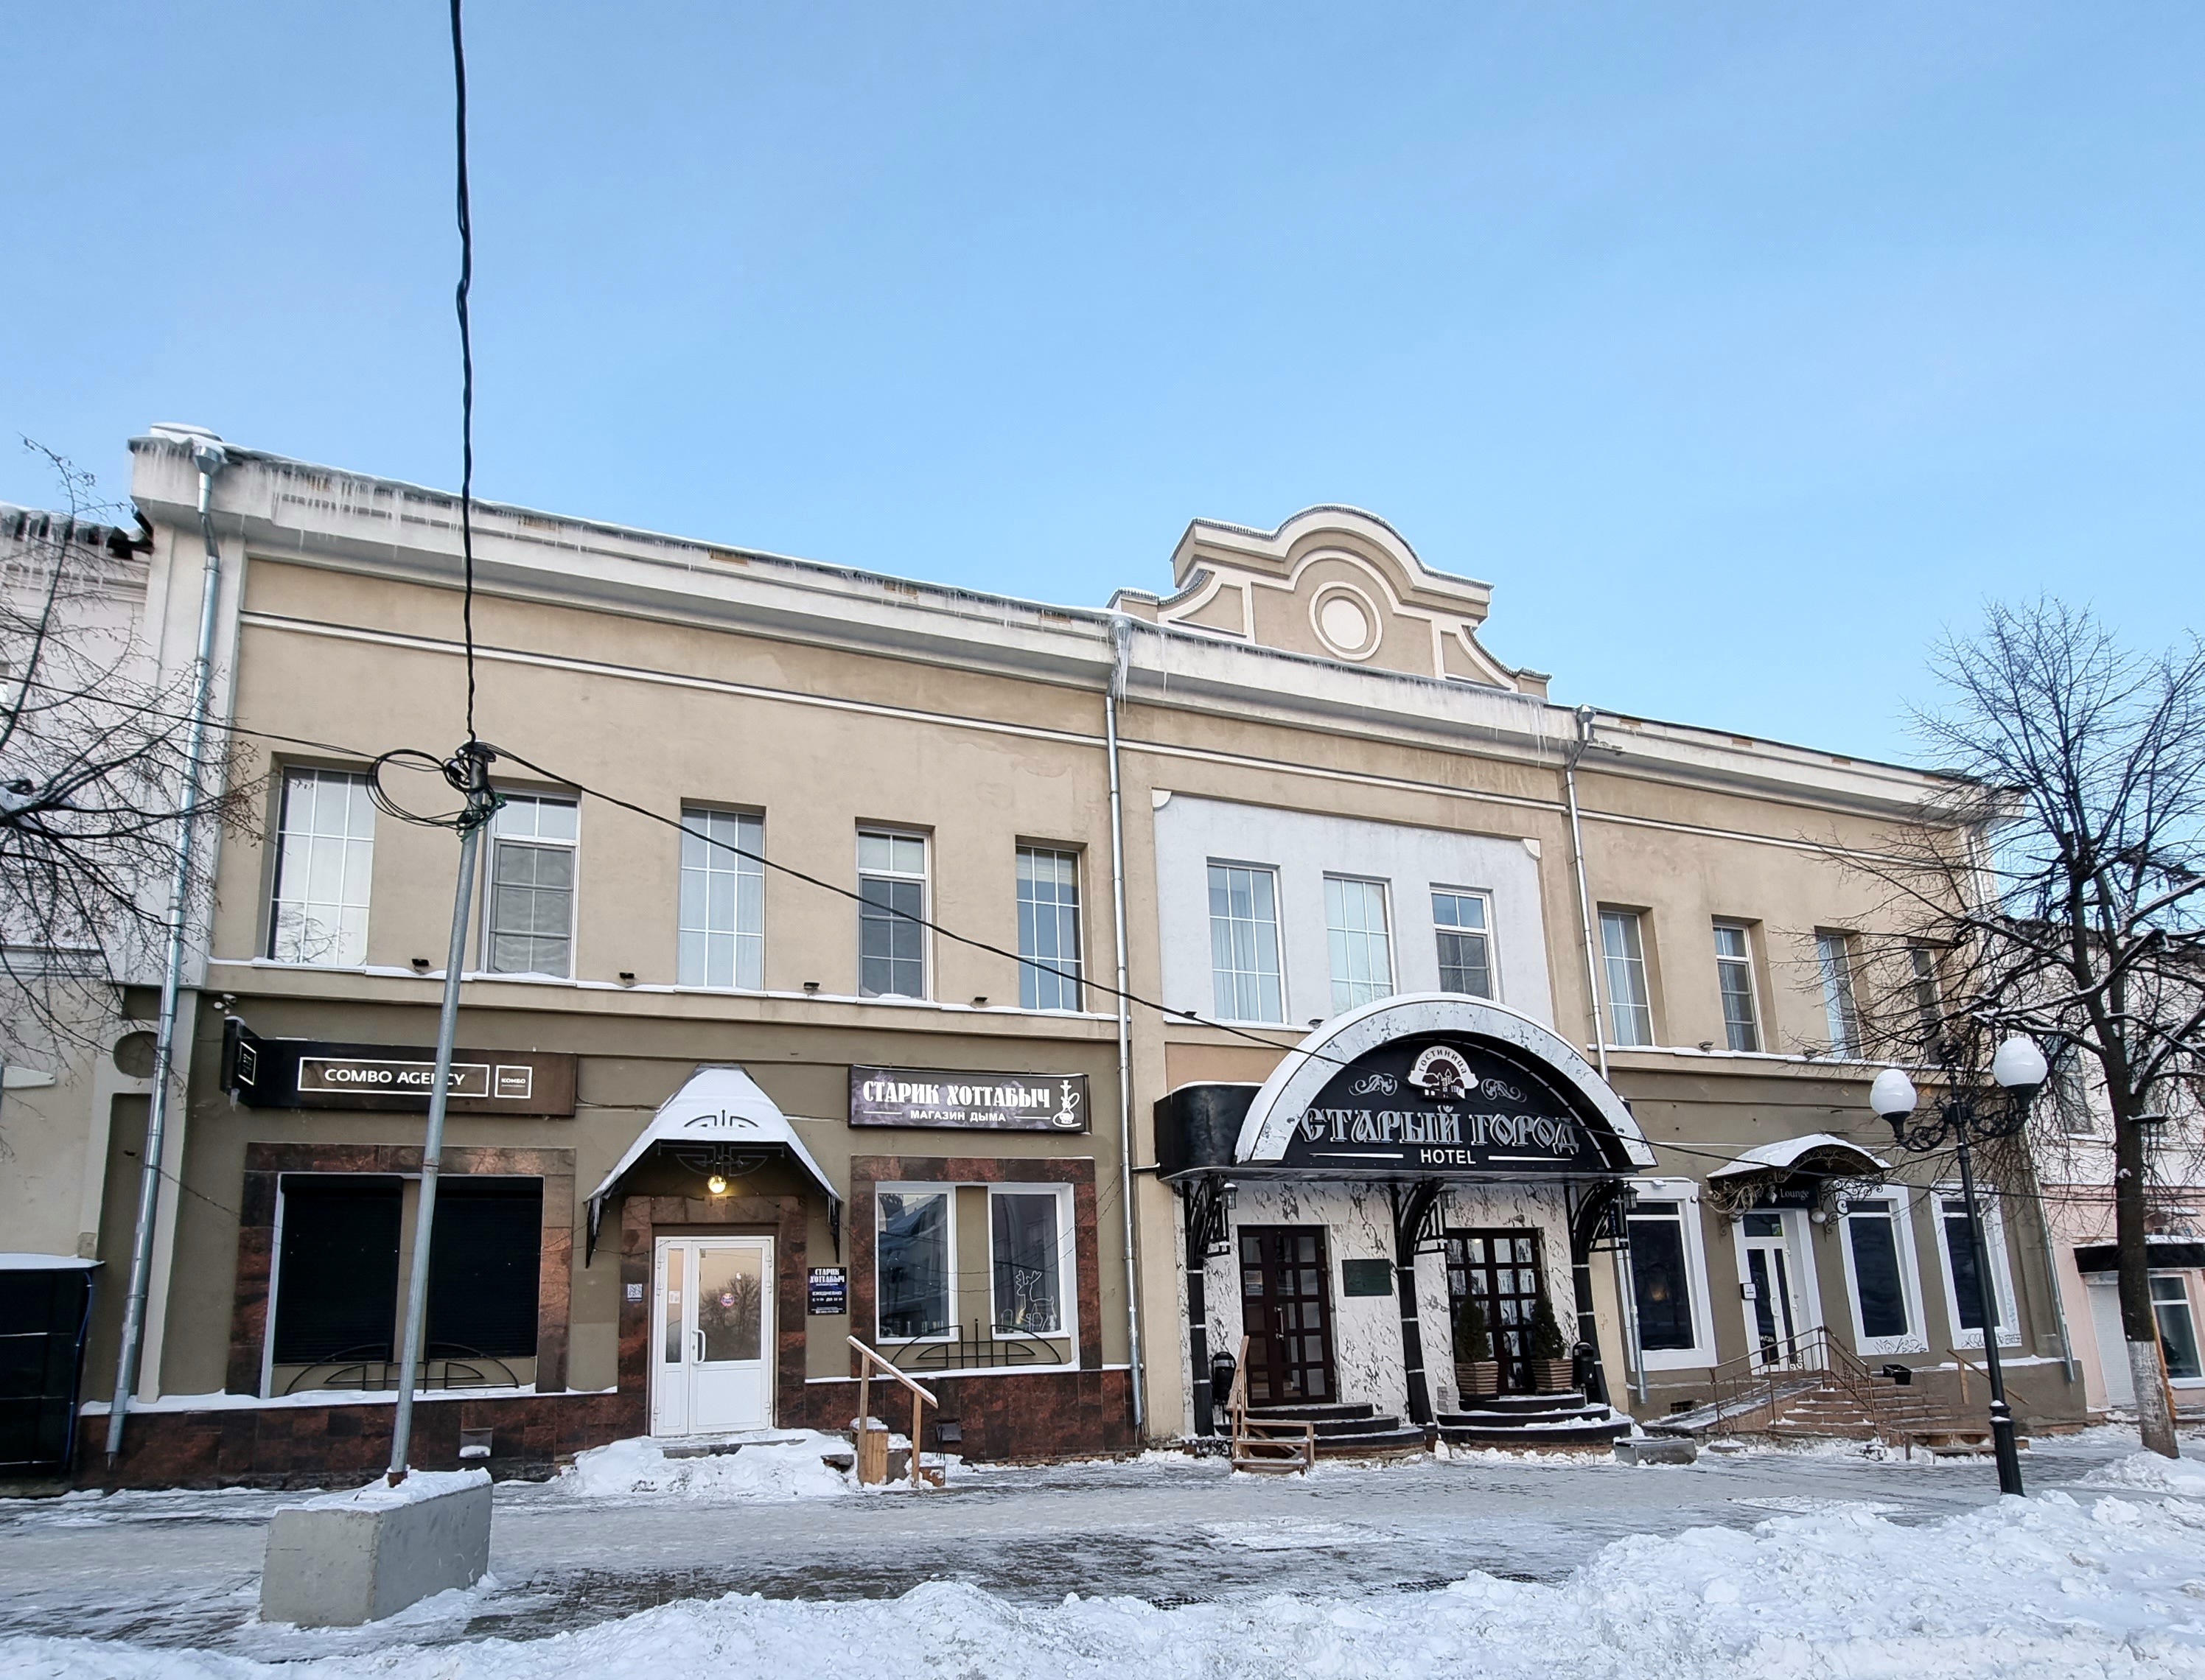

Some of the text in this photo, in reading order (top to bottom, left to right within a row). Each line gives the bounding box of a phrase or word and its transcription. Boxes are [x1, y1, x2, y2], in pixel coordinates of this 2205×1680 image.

[324, 1068, 392, 1084] COMBO
[863, 1080, 1051, 1108] СТАРИК ХОТТАБЫЧ
[910, 1110, 1006, 1122] МАГАЗИН ДЫМА
[1298, 1105, 1580, 1155] СТАРЫЙ ГОРОД
[1420, 1149, 1476, 1165] HOTEL
[1780, 1189, 1809, 1200] Lounge
